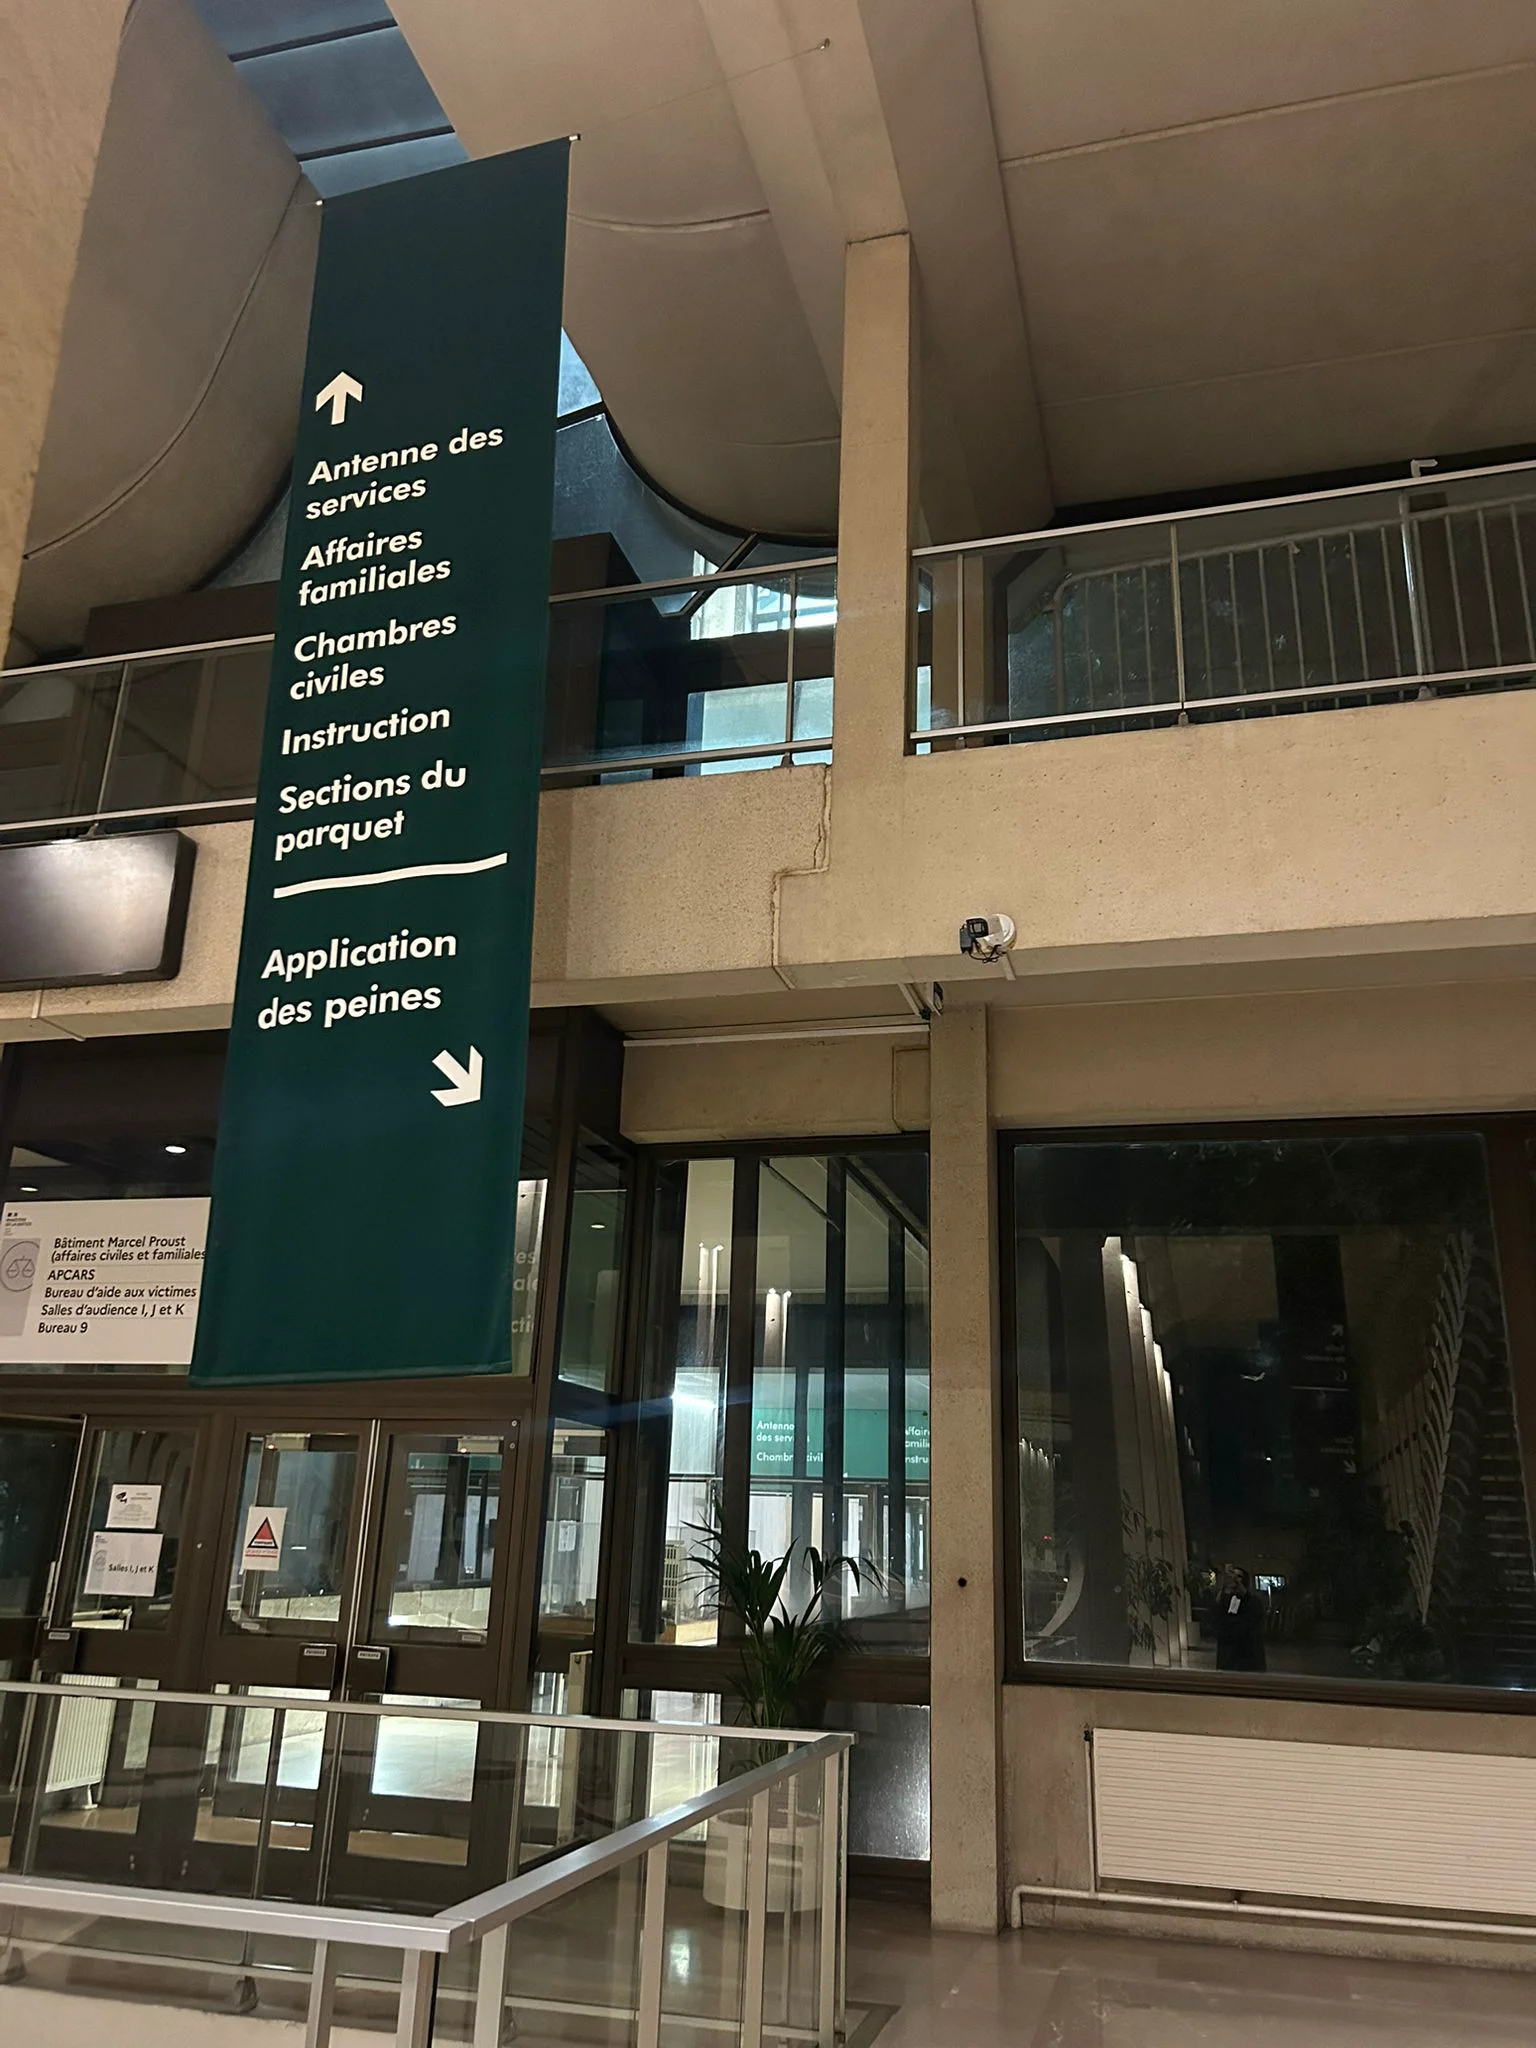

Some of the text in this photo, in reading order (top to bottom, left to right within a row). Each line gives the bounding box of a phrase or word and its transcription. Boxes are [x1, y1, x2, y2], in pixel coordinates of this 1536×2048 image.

[307, 427, 504, 486] Antenne des
[305, 478, 427, 520] services
[300, 530, 423, 572] Affaires
[298, 558, 452, 606] familiales
[293, 615, 457, 663] Chambres
[289, 662, 385, 700] civiles
[281, 707, 451, 755] Instruction
[278, 759, 468, 814] Sections du
[274, 810, 405, 861] parquet
[260, 929, 457, 983] Application
[257, 983, 442, 1030] des peines
[51, 1250, 97, 1264] (affaires
[99, 1249, 134, 1261] civiles
[137, 1250, 150, 1261] et
[54, 1235, 187, 1249] Bâtiment Marcel Proust
[44, 1286, 84, 1299] Bureau
[124, 1288, 145, 1298] aux
[148, 1285, 197, 1298] victimes
[46, 1268, 96, 1281] APCARS
[37, 1321, 89, 1334] Bureau 9
[41, 1303, 73, 1316] Salles
[149, 1304, 158, 1318] J
[159, 1305, 172, 1316] et
[175, 1303, 186, 1316] K
